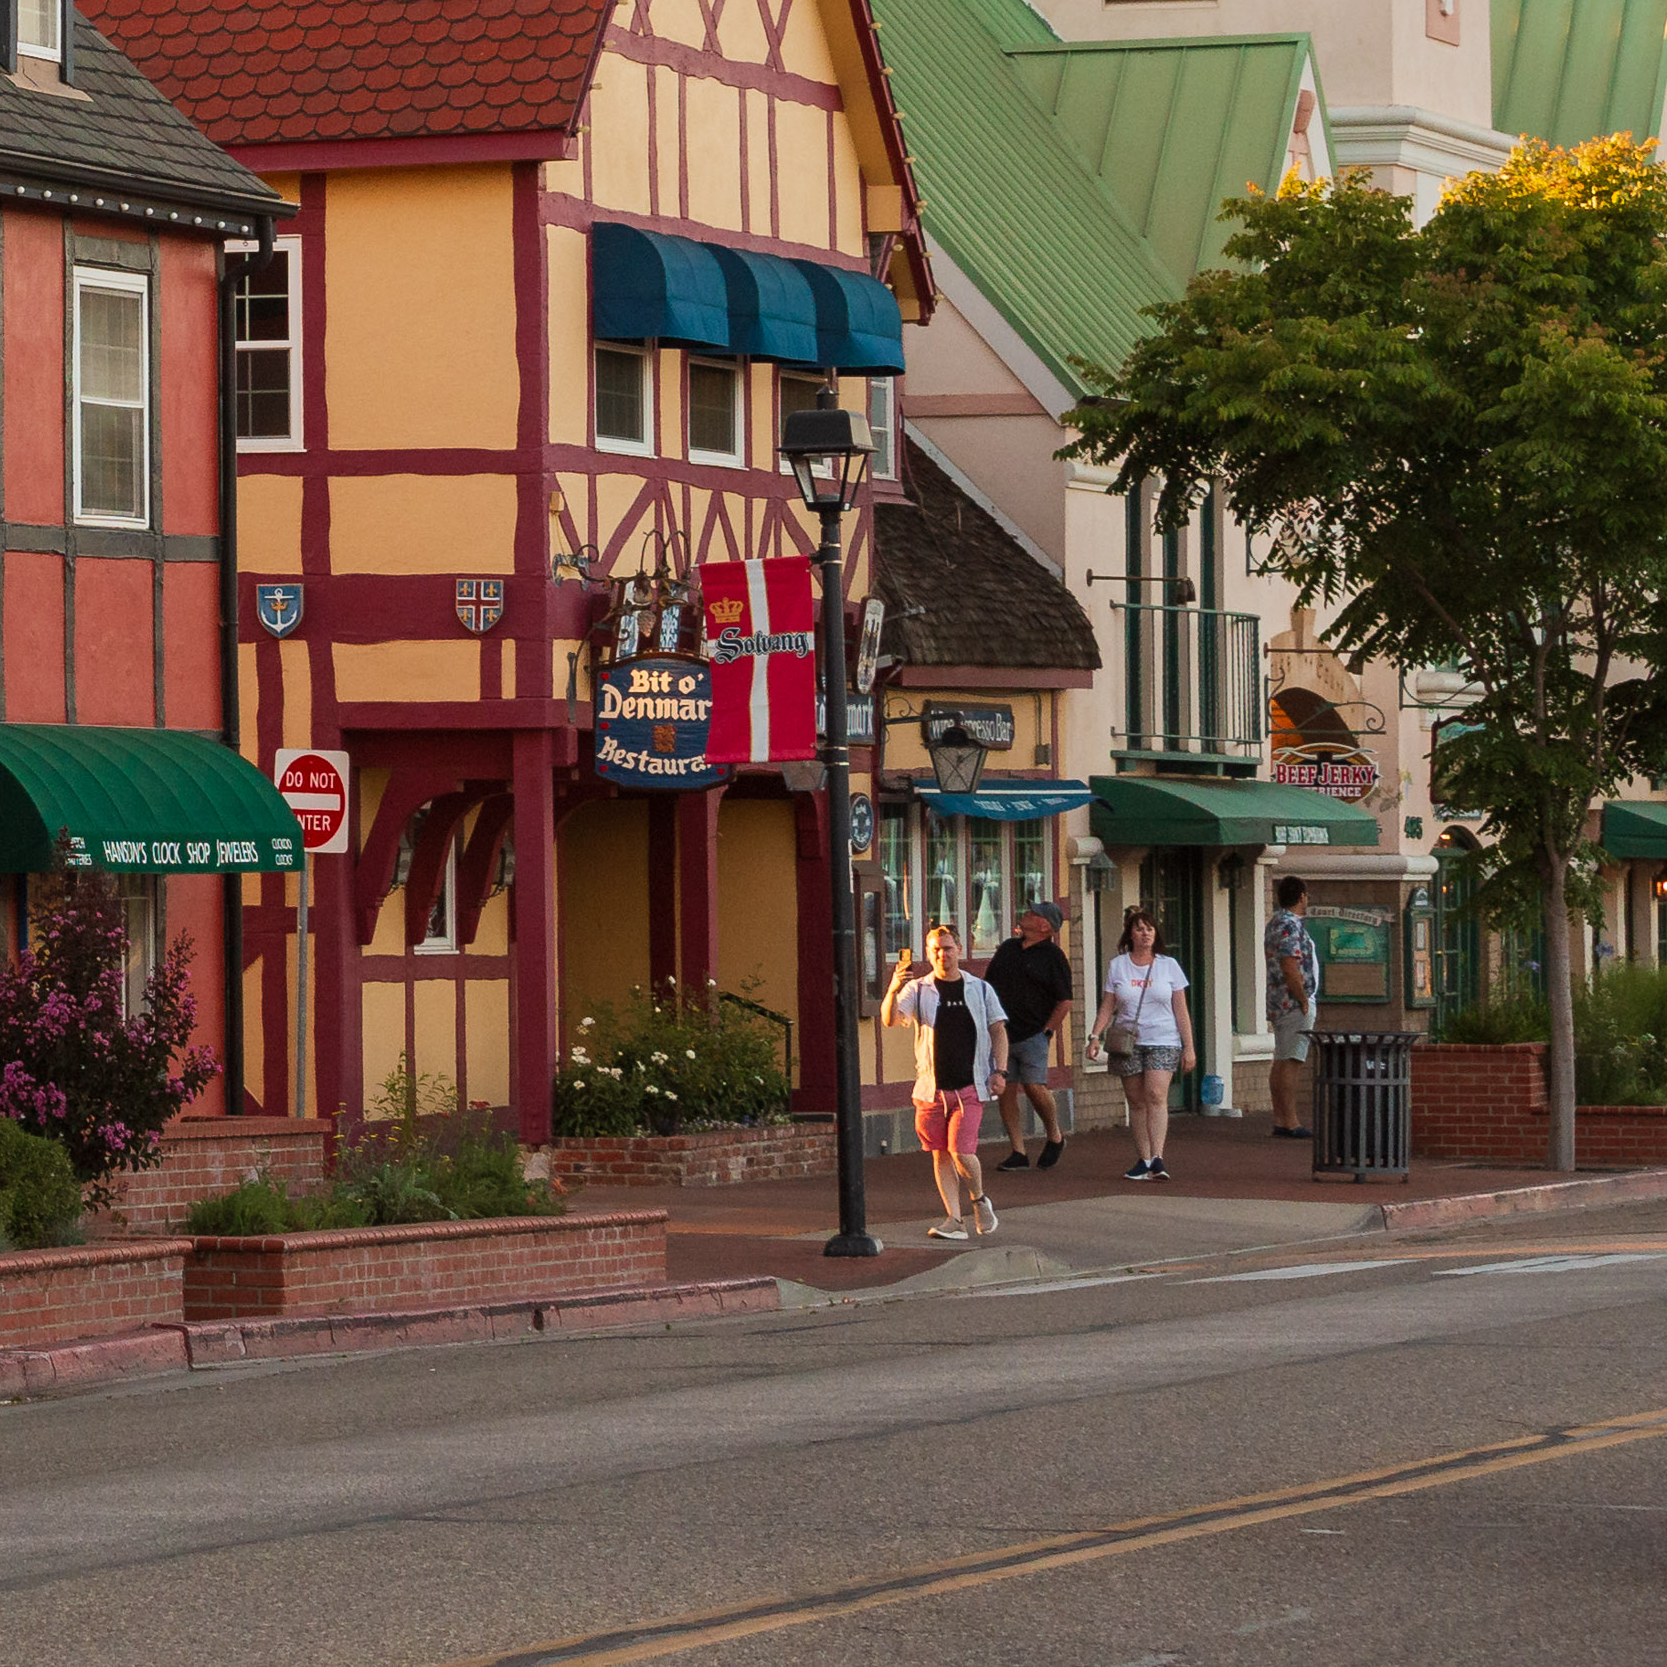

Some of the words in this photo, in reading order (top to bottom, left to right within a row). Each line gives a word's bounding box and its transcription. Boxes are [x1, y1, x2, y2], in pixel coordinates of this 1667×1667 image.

[715, 627, 810, 665] Solvang
[628, 668, 673, 694] Bit
[678, 673, 705, 695] o'
[598, 684, 713, 722] Denmar
[847, 697, 874, 736] mark
[995, 712, 1012, 742] Bar
[597, 736, 712, 775] Restaura
[285, 771, 303, 788] DO
[309, 772, 337, 789] NOT
[1275, 762, 1316, 783] BEEF
[1316, 761, 1372, 784] JERKY
[296, 814, 331, 832] NTER
[102, 840, 147, 865] HANSON'S
[152, 841, 182, 865] CLOCK
[186, 842, 211, 865] SHOP
[216, 839, 259, 867] JEWELERS
